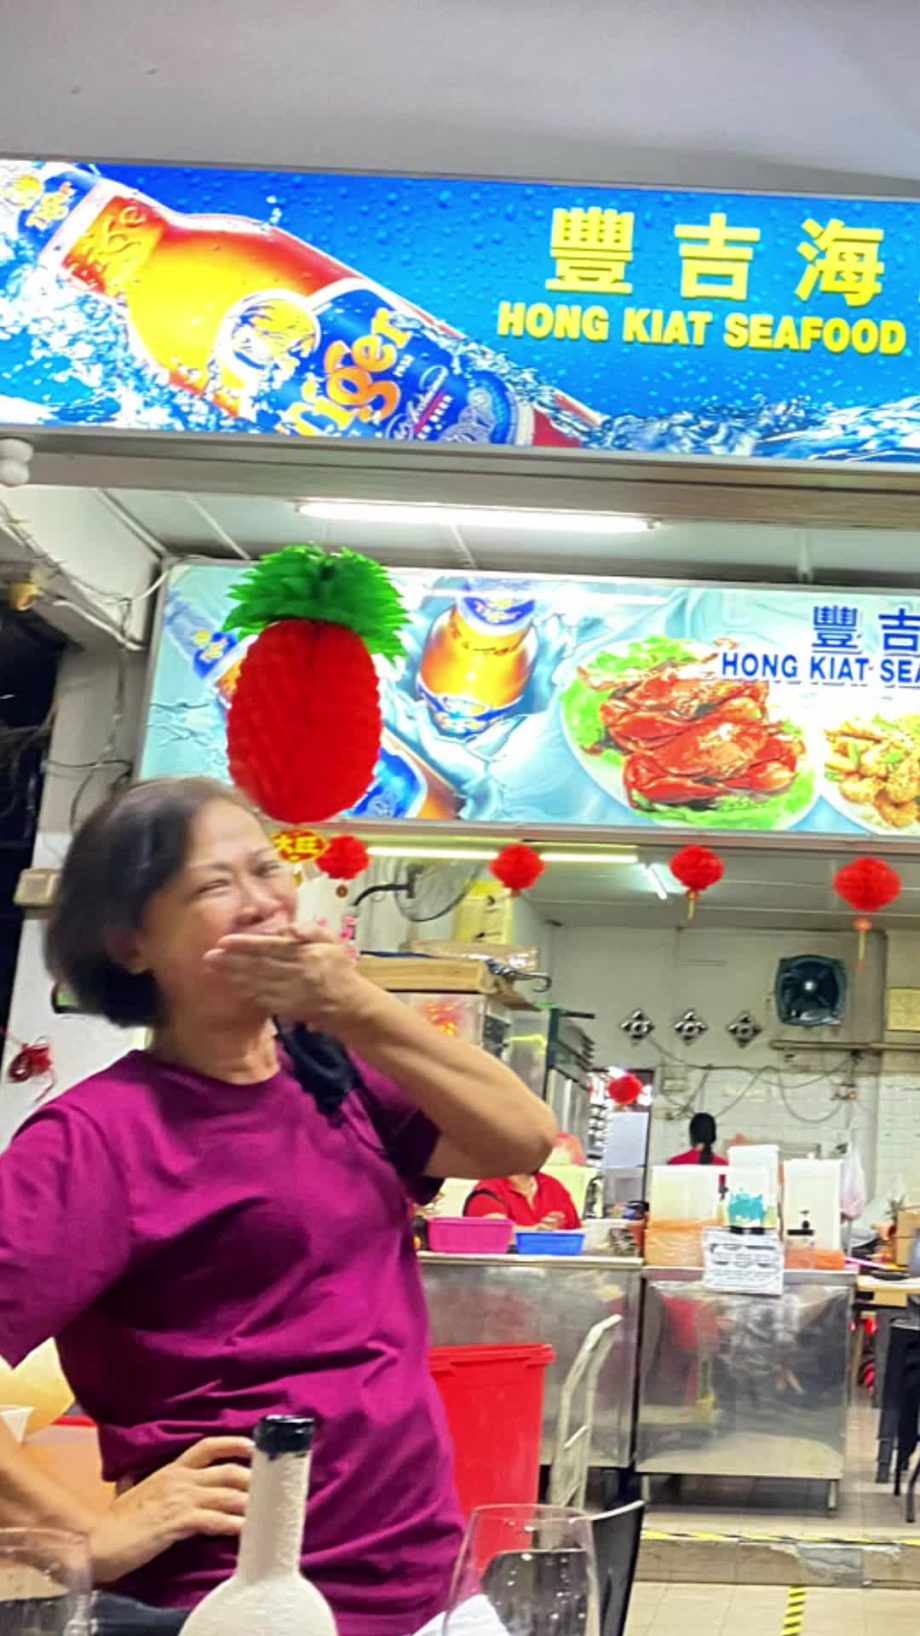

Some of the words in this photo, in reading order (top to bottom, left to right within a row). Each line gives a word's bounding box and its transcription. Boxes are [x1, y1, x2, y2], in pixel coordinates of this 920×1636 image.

[545, 206, 885, 307] 豐吉海
[497, 302, 609, 341] HONG
[623, 307, 713, 346] KIAT
[723, 313, 907, 355] SEAFOOD
[811, 605, 920, 652] 豐吉
[722, 652, 798, 678] HONG
[810, 656, 869, 681] KIAT
